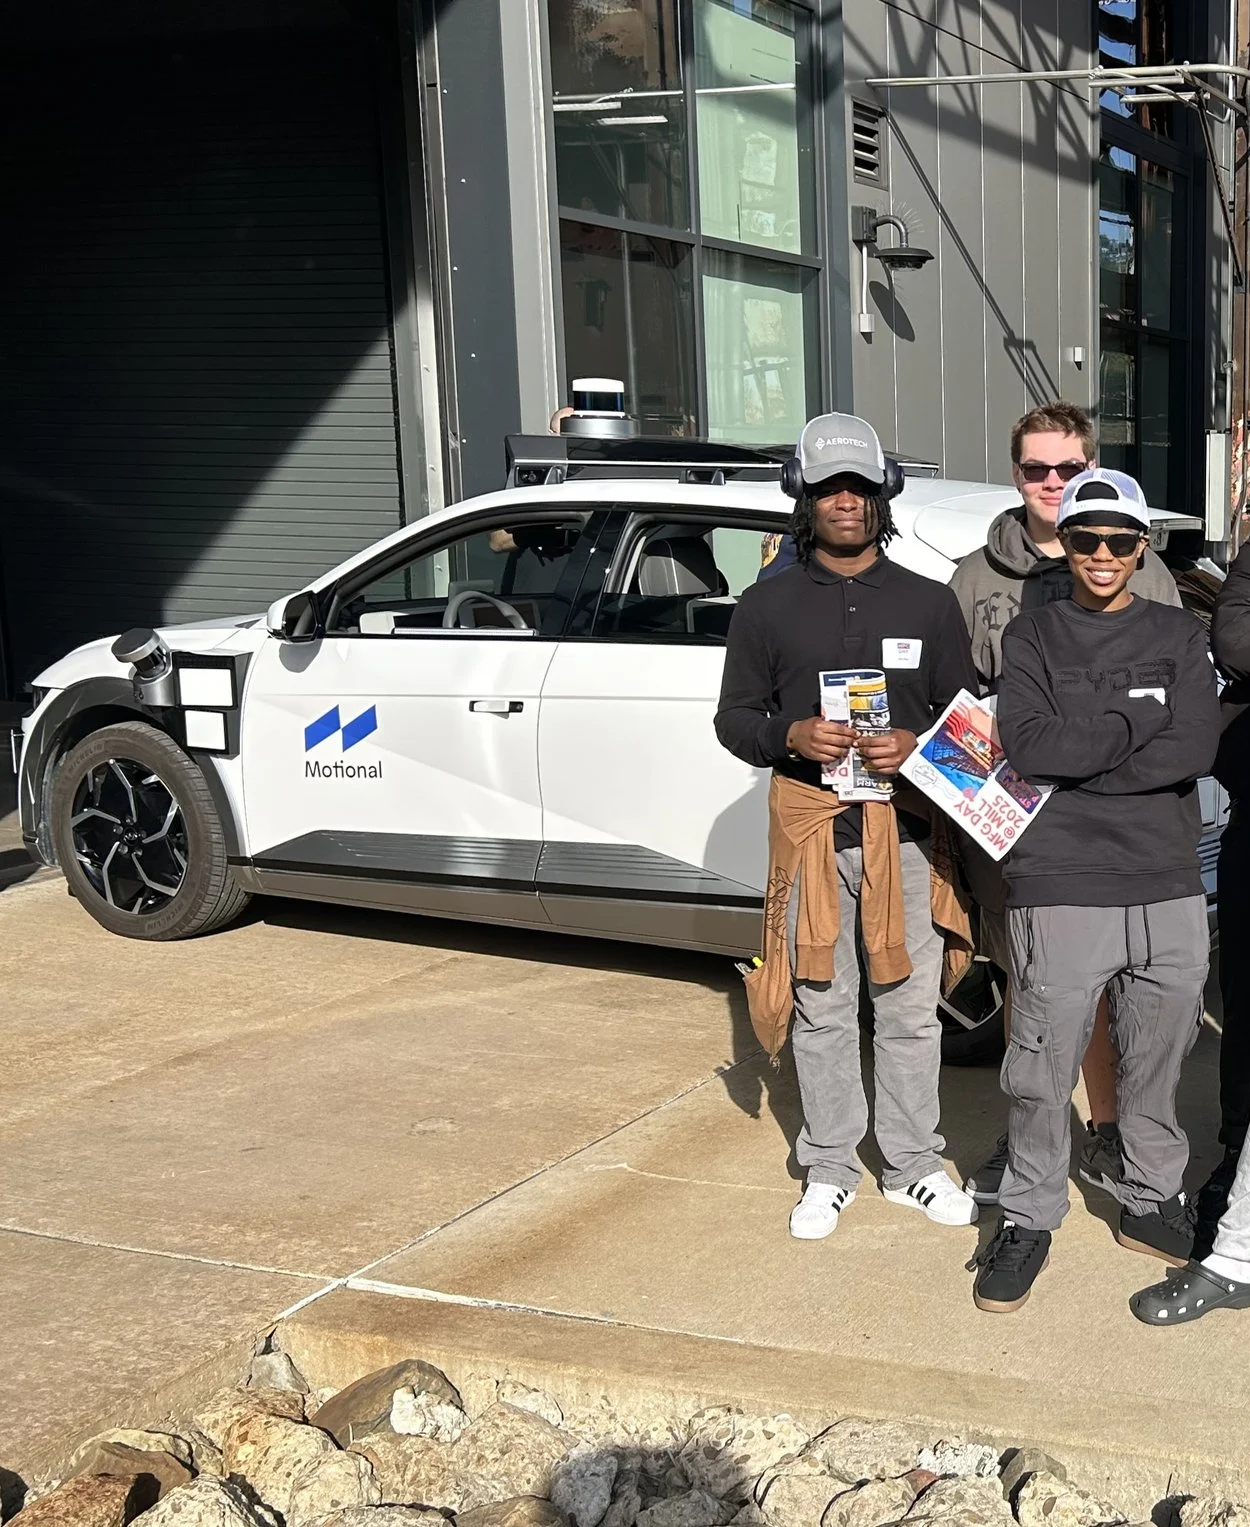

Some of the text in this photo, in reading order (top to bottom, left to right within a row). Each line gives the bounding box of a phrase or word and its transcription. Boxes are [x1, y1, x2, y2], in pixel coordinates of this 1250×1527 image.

[826, 437, 869, 449] AEROTECH
[305, 760, 382, 778] Motional
[980, 798, 1006, 828] MILL
[994, 795, 1026, 829] 2025
[953, 799, 1009, 851] MFG DAY
[1003, 826, 1016, 840] @
